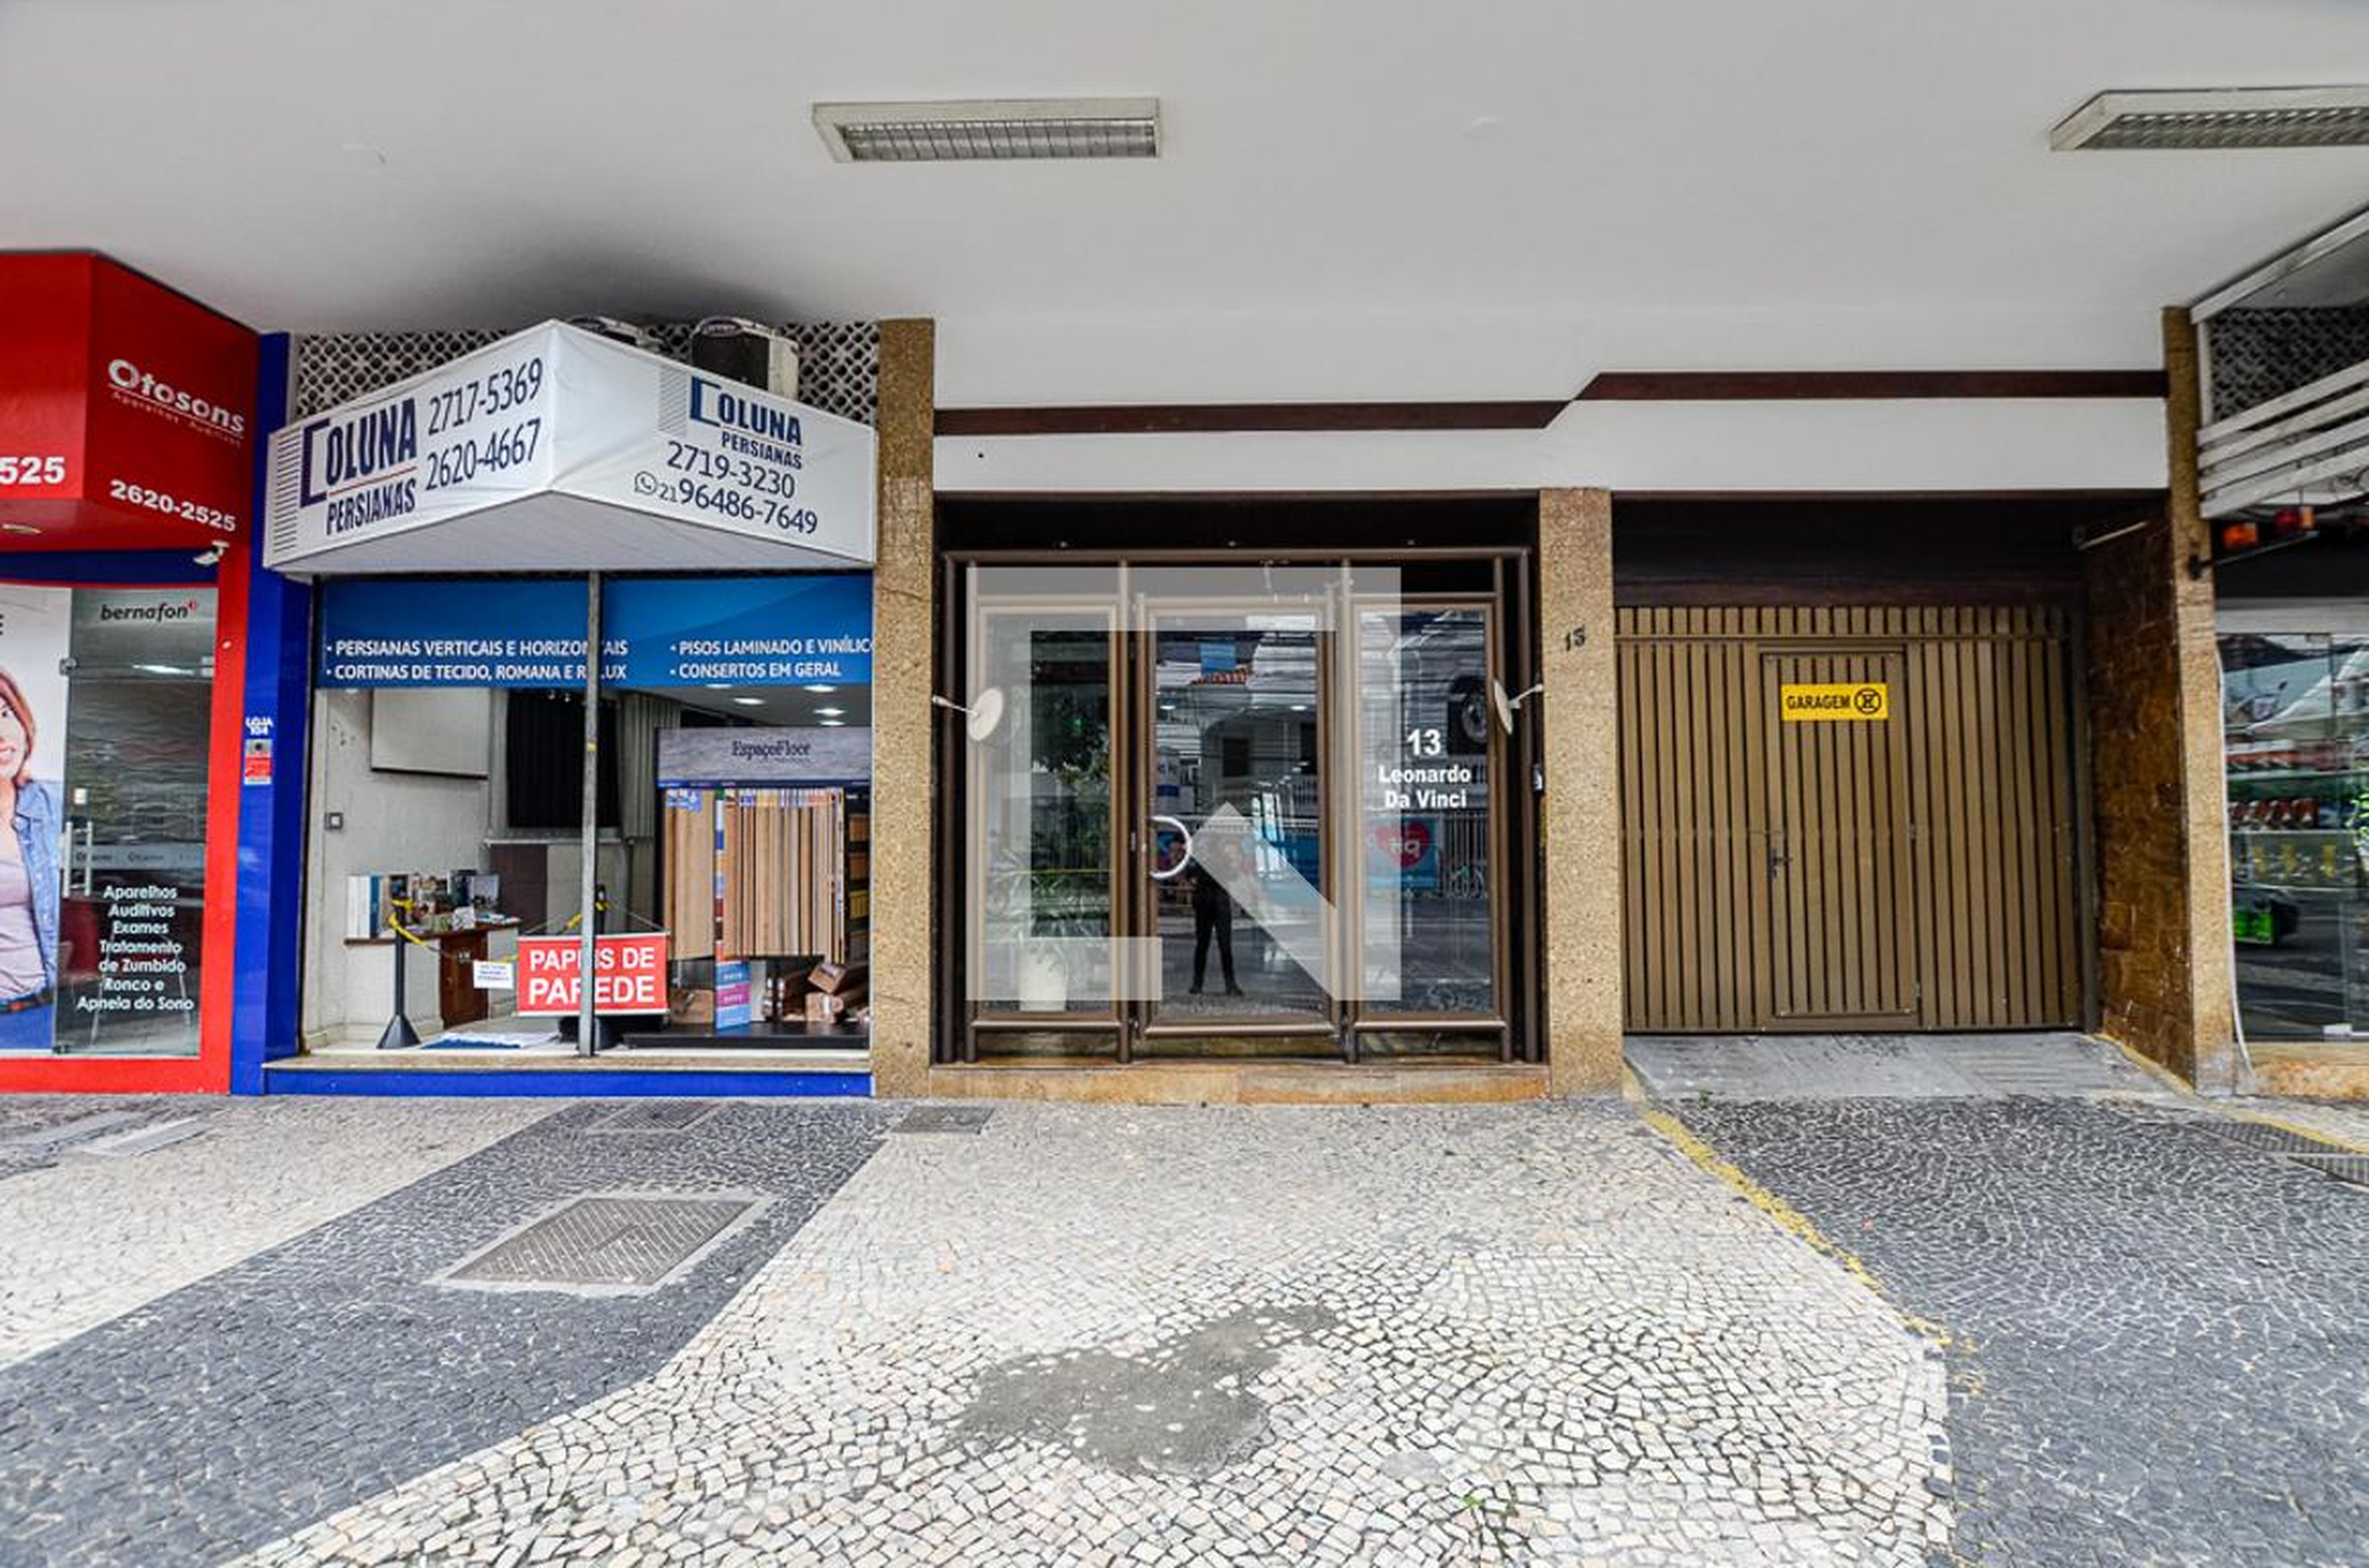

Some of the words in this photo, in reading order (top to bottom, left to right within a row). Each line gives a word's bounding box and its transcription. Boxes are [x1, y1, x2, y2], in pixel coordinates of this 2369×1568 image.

[107, 358, 244, 433] Otosons
[428, 357, 544, 436] 2717-5369
[690, 376, 802, 446] COLUNA
[300, 397, 418, 508] COLUNA
[426, 418, 542, 491] 2620-4667
[722, 431, 803, 469] PERSIANAS
[667, 440, 795, 498] 2719-3230
[110, 479, 236, 532] 2620-2525
[326, 477, 416, 535] PERSIANAS
[659, 483, 677, 503] 21
[679, 477, 818, 534] 96486-7649
[101, 602, 188, 622] bernafon
[336, 639, 421, 656] PERSIANAS
[423, 640, 504, 656] VERTICAIS
[506, 640, 516, 655] E
[520, 640, 629, 655] HORIZOAIS
[679, 640, 721, 655] PISOS
[724, 640, 802, 654] LAMINADO
[806, 639, 814, 654] E
[334, 664, 408, 679] CORTINAS
[411, 665, 432, 679] DE
[435, 664, 492, 681] TECIDO,
[495, 664, 561, 679] ROMANA
[564, 665, 574, 679] E
[577, 664, 627, 679] RUX
[679, 663, 766, 678] CONSERTOS
[769, 662, 792, 677] EM
[794, 661, 841, 677] GERAL
[1786, 695, 1850, 709] GARAGEM
[1407, 728, 1441, 756] 13
[1378, 765, 1472, 783] Leonardo
[1385, 790, 1410, 808] Da
[1416, 788, 1467, 808] Vinci
[103, 885, 178, 901] Aparelhos
[108, 904, 175, 917] Auditivos
[112, 920, 169, 934] Exames
[99, 940, 183, 953] Tratamento
[99, 959, 119, 972] de
[122, 959, 186, 973] Zumbido
[622, 947, 655, 969] DE
[104, 978, 151, 991] Ronco
[155, 980, 165, 991] e
[77, 996, 131, 1012] Apneia
[134, 996, 154, 1010] do
[157, 997, 194, 1010] Sono
